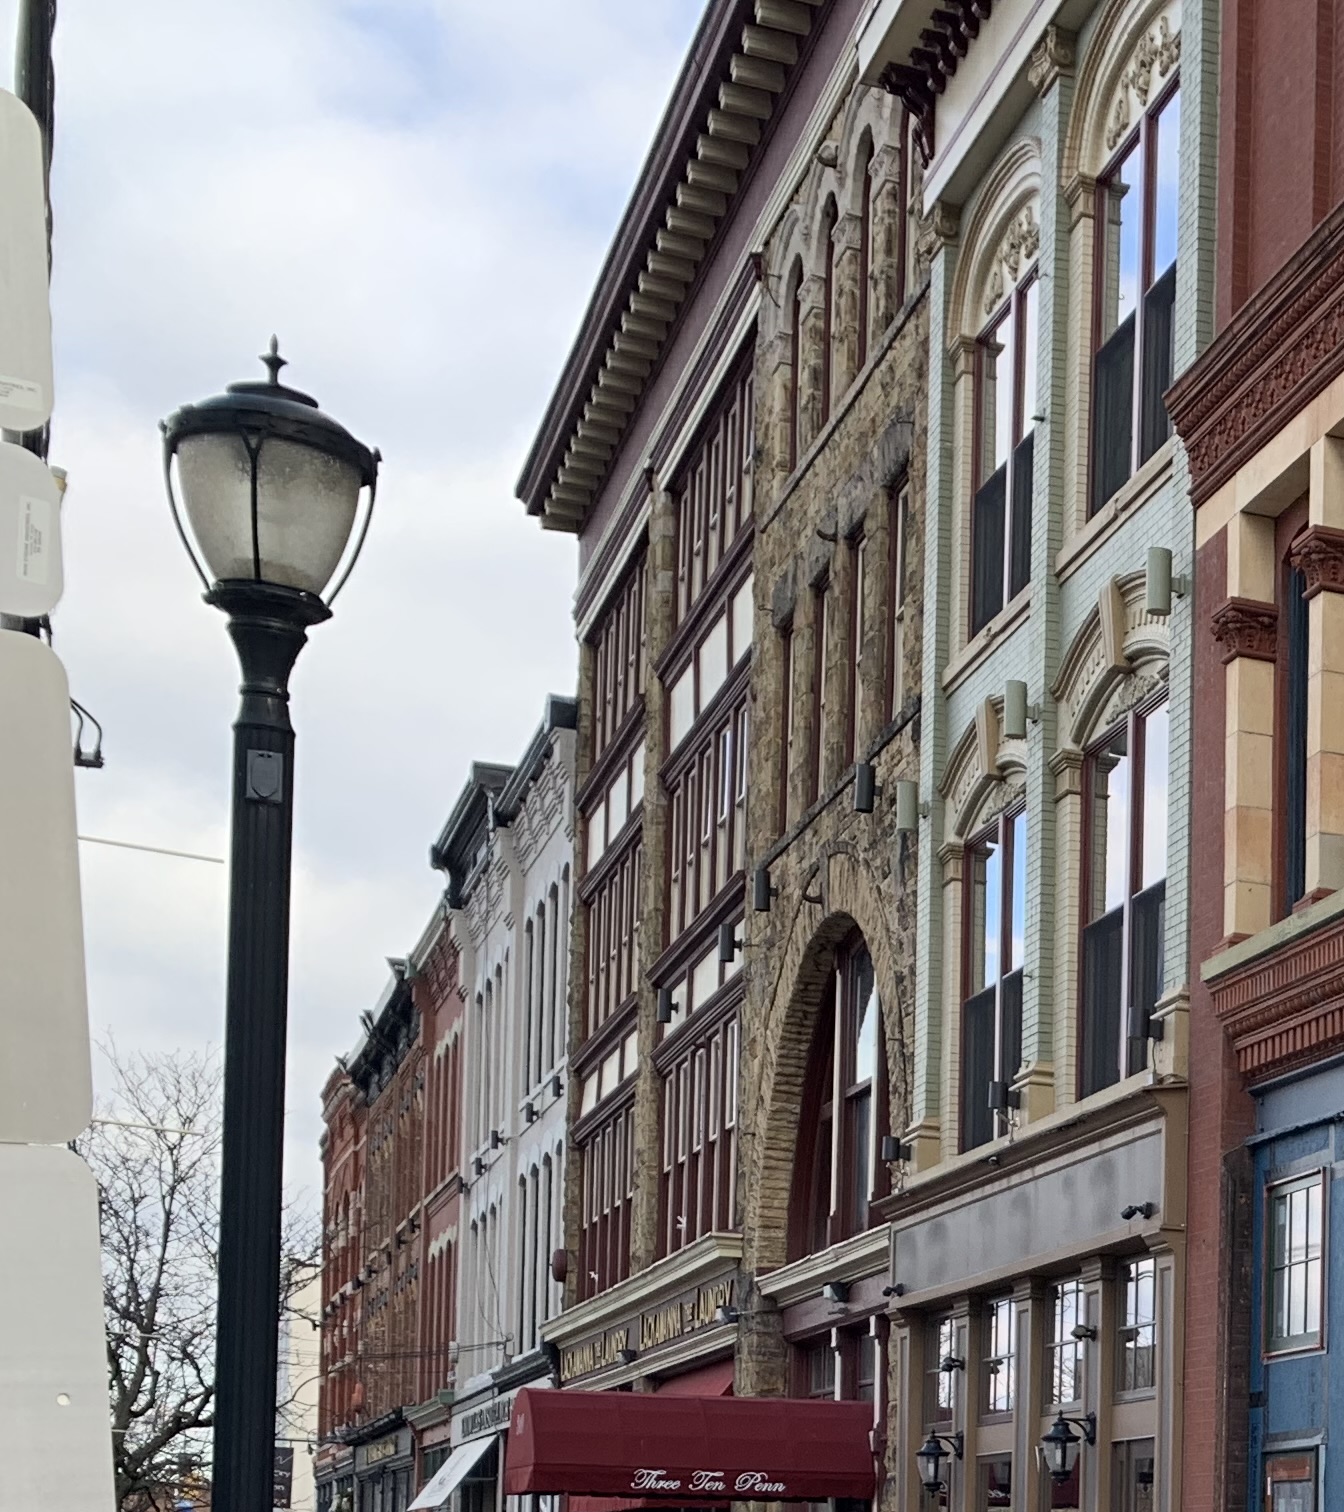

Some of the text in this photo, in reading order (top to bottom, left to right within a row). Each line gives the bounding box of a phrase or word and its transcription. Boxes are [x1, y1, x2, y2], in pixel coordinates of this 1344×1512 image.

[639, 1302, 683, 1351] LACKAWANNA
[560, 1342, 594, 1381] LACKAWANNA
[630, 1468, 787, 1493] Three Ten Penn
